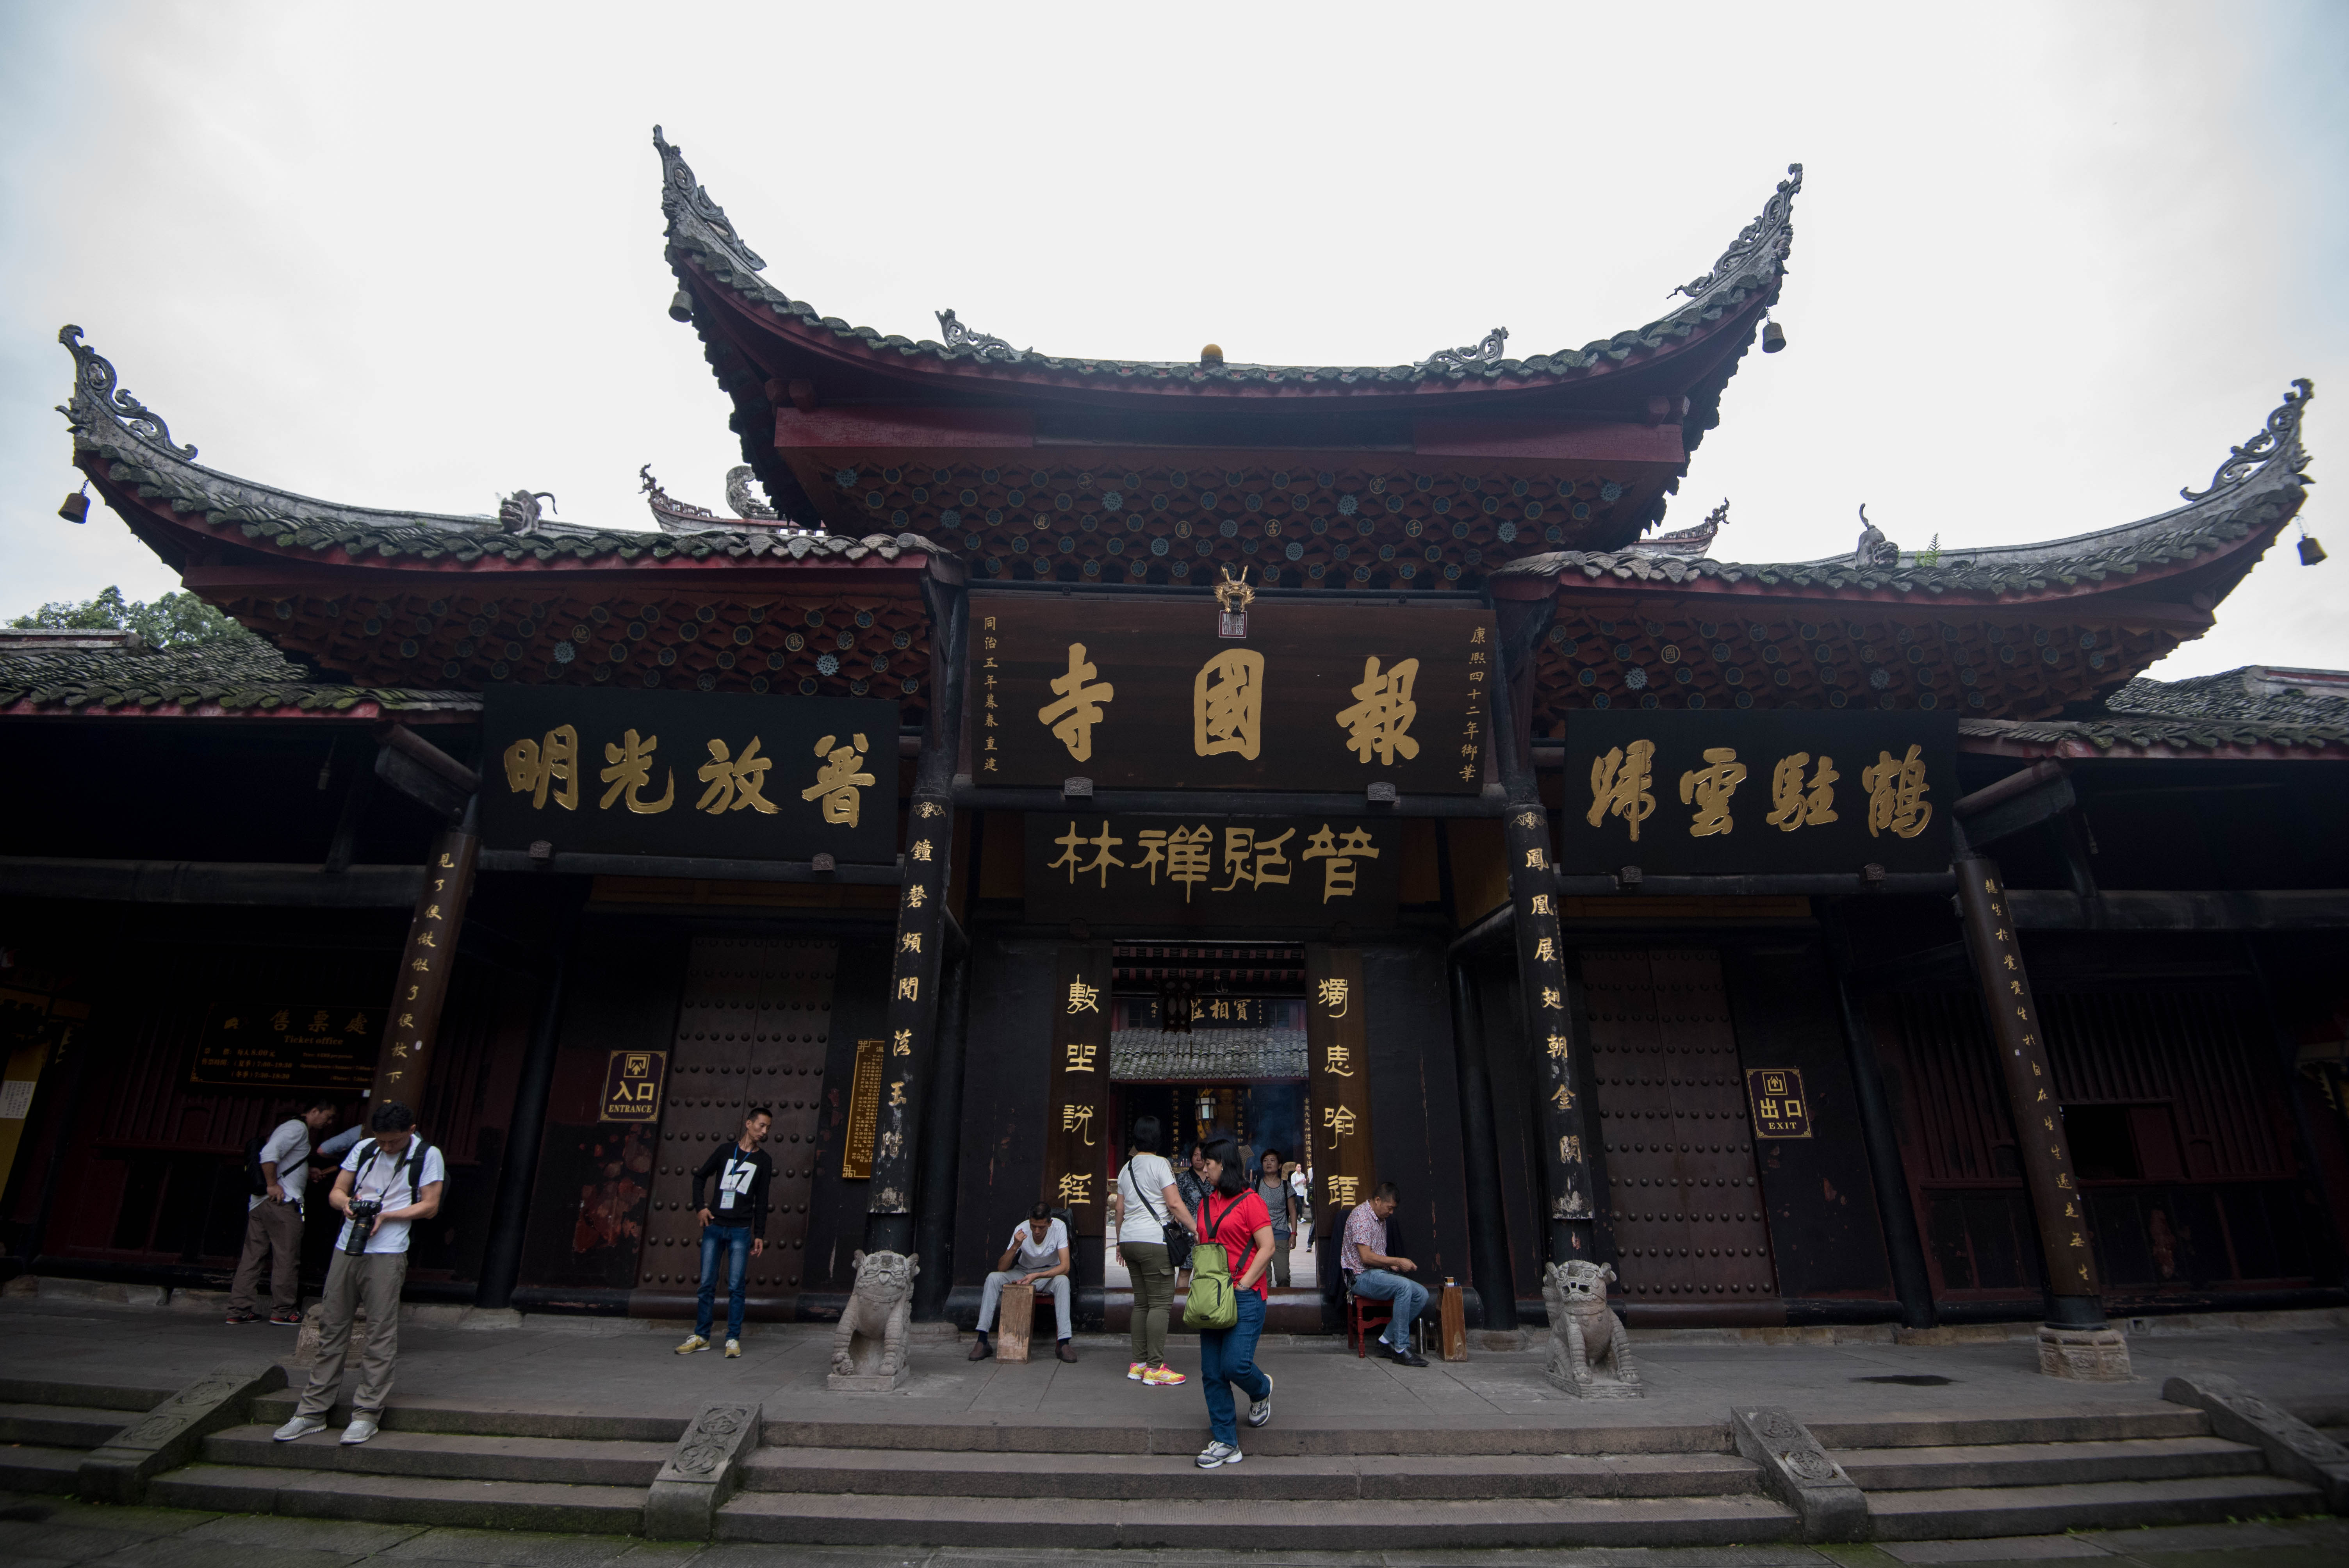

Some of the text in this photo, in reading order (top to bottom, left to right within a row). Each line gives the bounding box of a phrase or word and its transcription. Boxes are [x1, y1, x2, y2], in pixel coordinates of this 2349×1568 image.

[983, 616, 998, 772] 同治五年暮春重建
[1038, 643, 1420, 766] 報國寺
[504, 723, 876, 829] 普放光明
[284, 1035, 344, 1046] Ticket office
[613, 1080, 654, 1101] 入口
[608, 1105, 652, 1113] ENTRANCE
[1760, 1098, 1802, 1119] 出口
